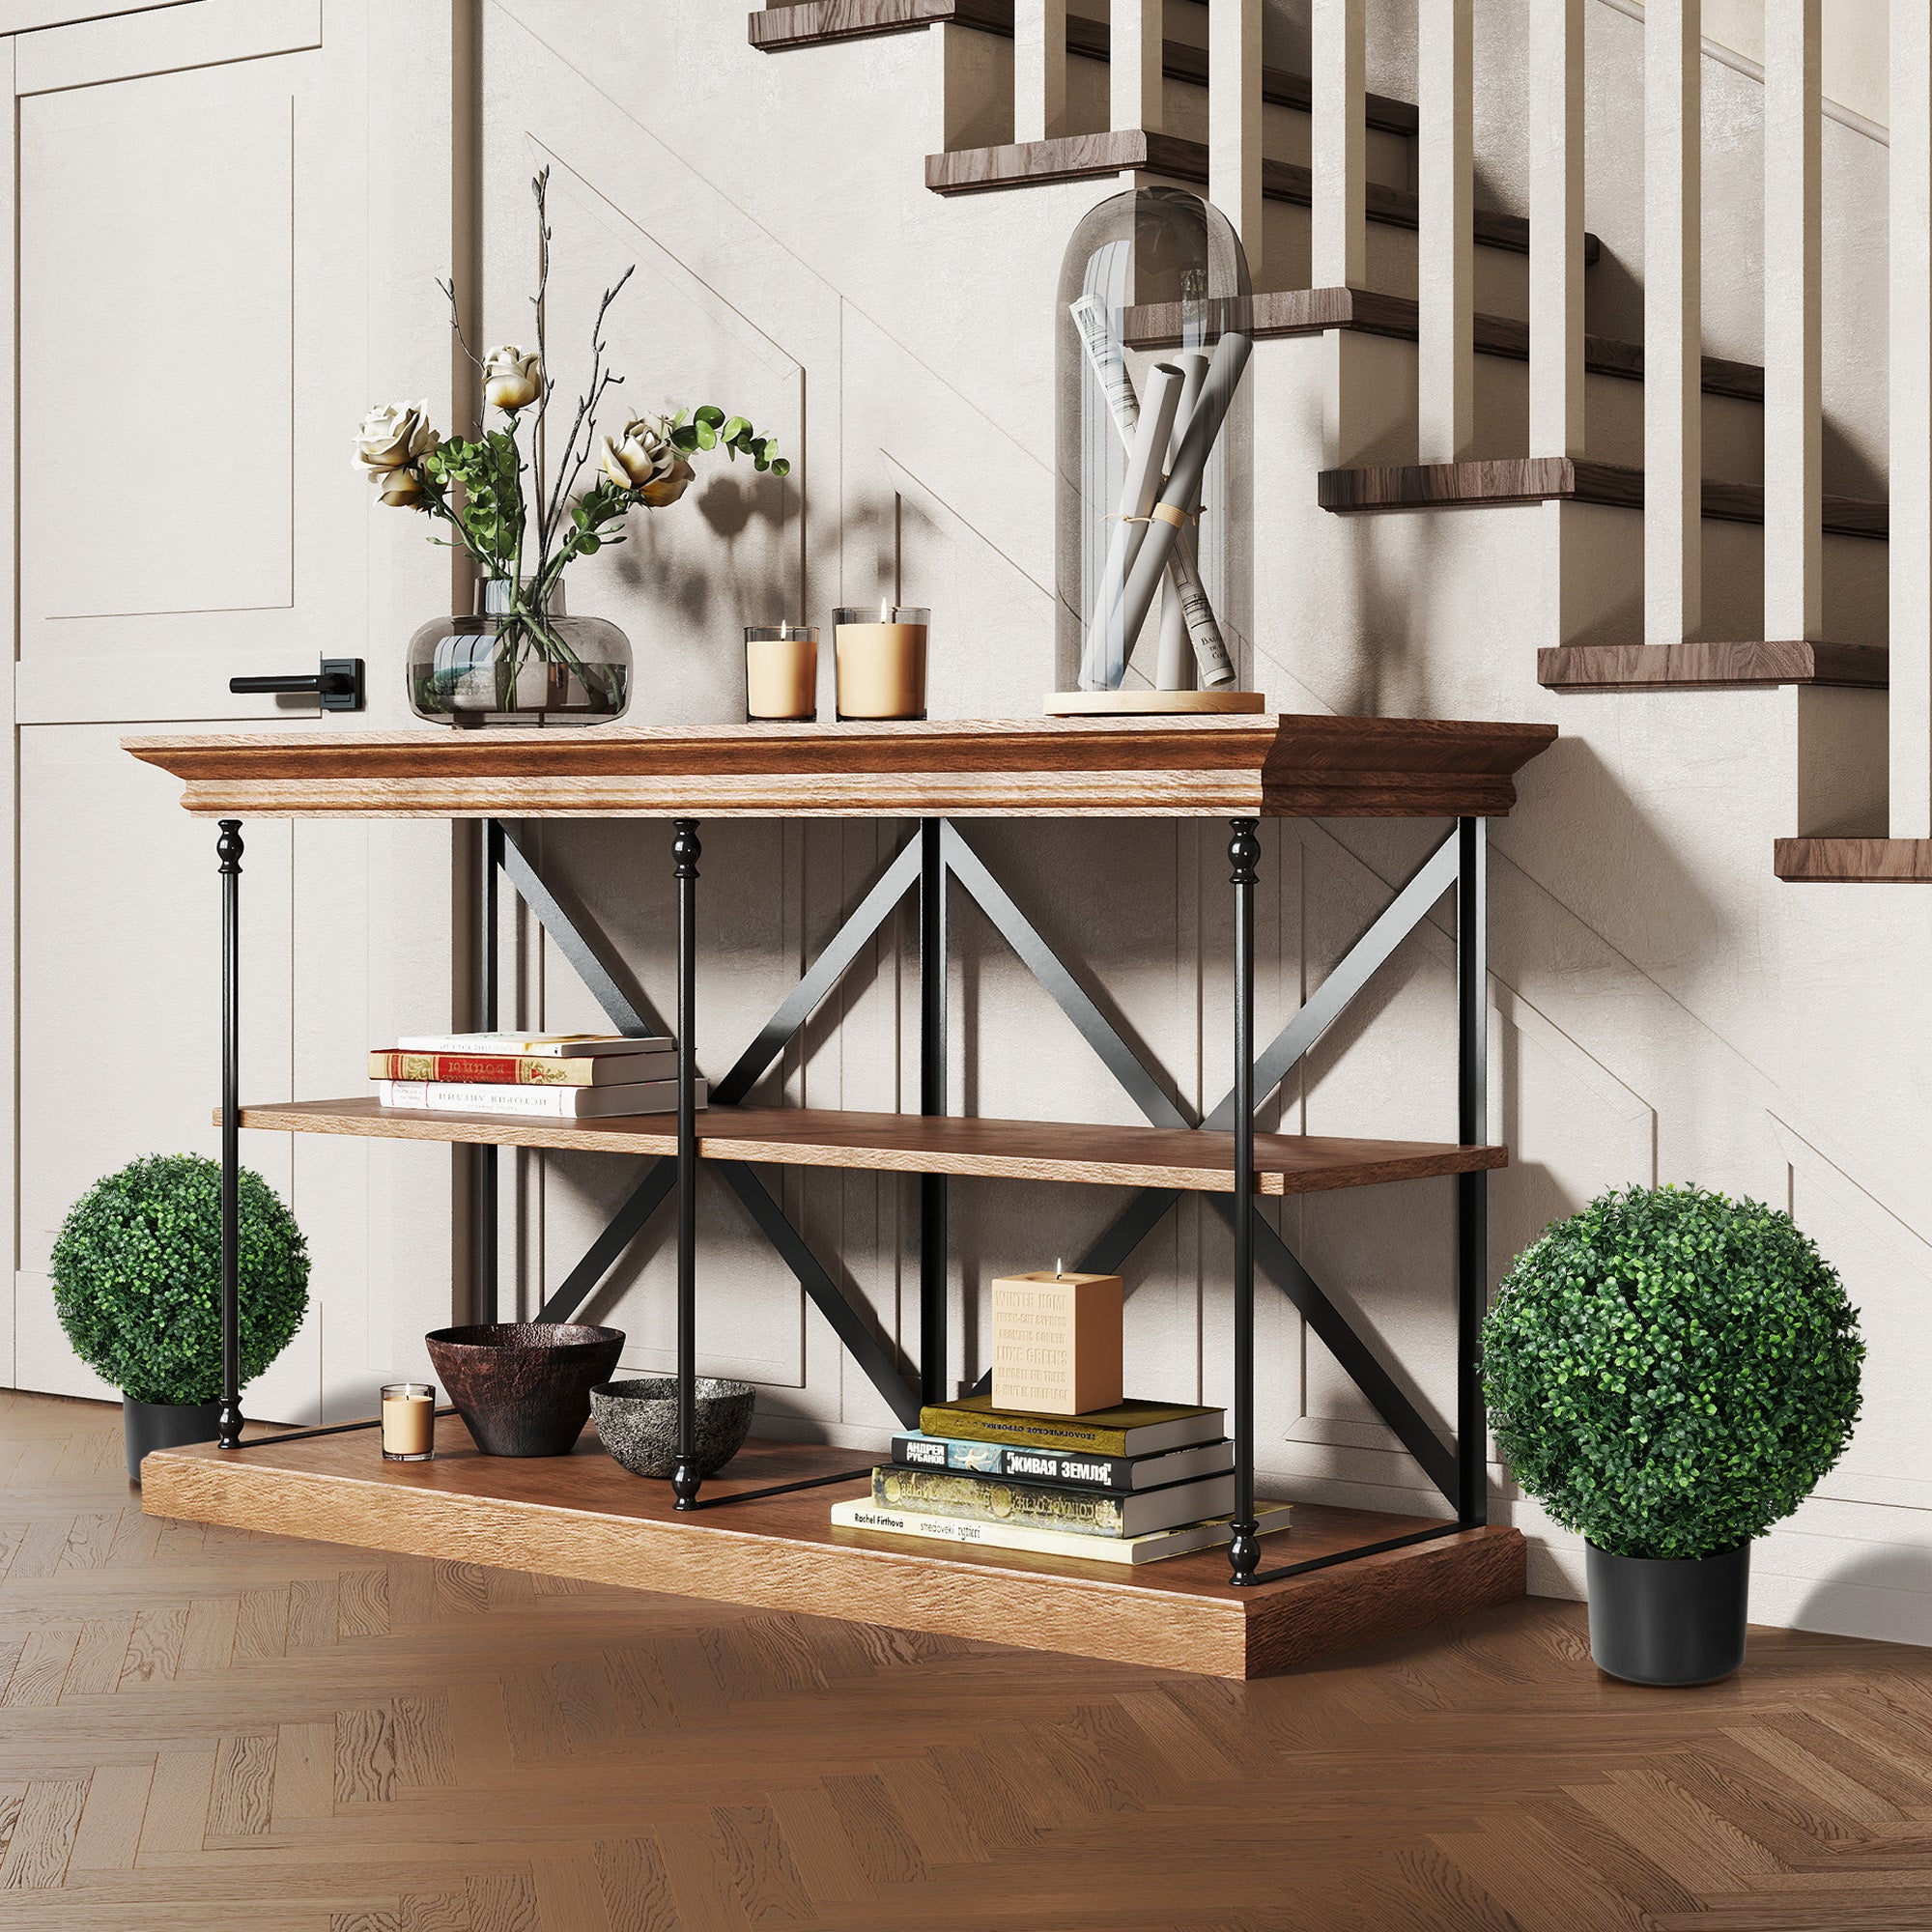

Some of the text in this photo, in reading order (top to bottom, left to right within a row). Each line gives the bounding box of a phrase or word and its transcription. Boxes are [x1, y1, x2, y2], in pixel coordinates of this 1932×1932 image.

[491, 1095, 548, 1106] ИСТОРИЯ
[995, 1291, 1069, 1311] WINTER HOME
[1026, 1348, 1067, 1365] GREENS
[1027, 1427, 1096, 1440] ГЕОЛОГИЧЕСКОЕ
[906, 1452, 946, 1465] РУБАНОВ
[854, 1513, 904, 1528] Rachel Firthová
